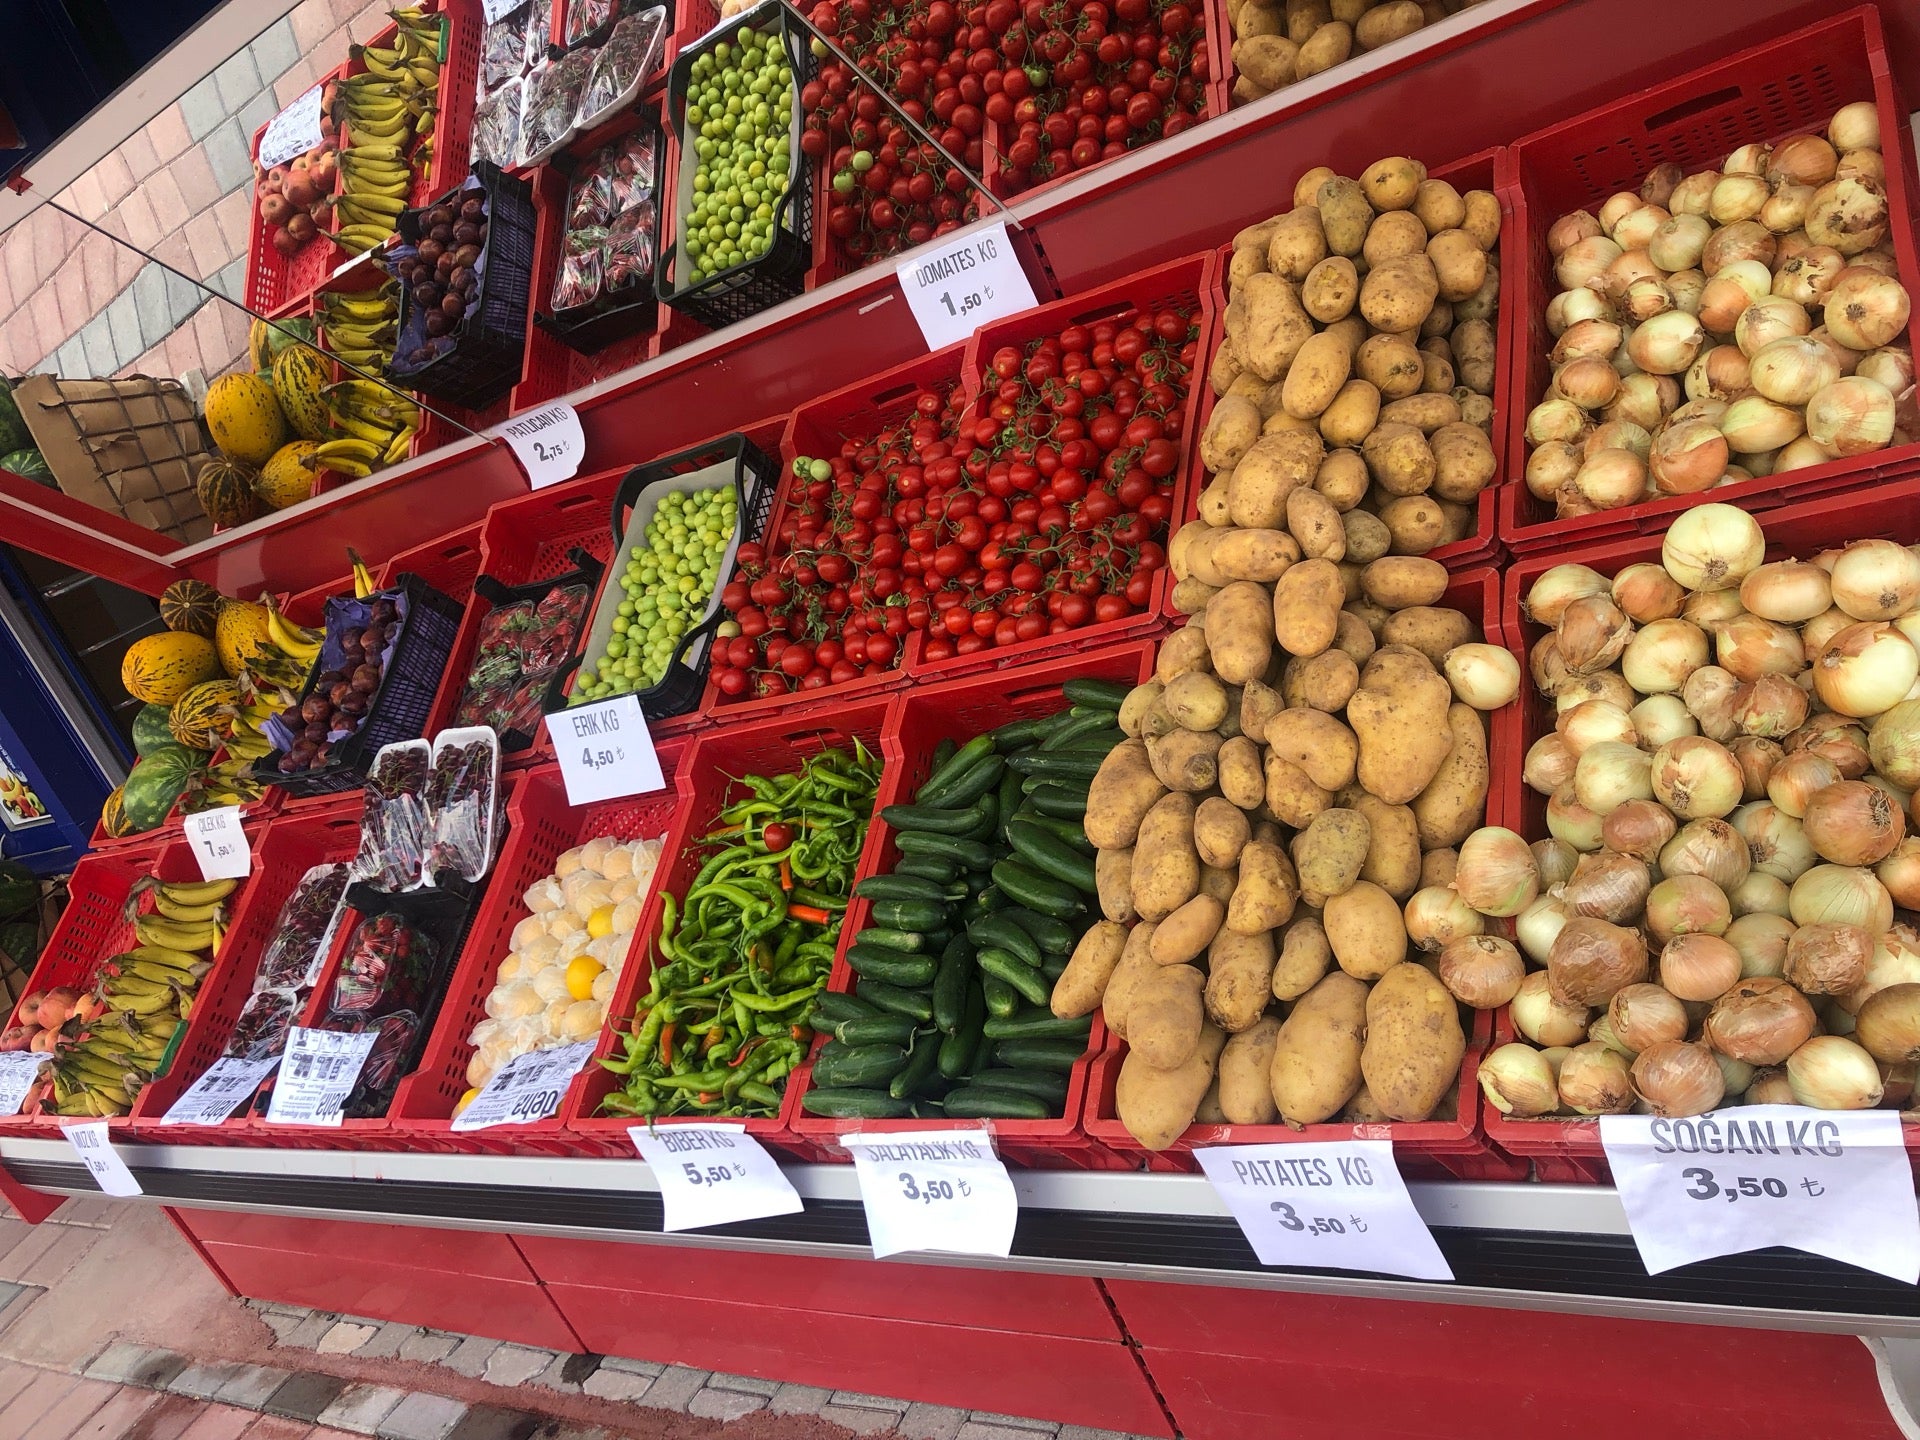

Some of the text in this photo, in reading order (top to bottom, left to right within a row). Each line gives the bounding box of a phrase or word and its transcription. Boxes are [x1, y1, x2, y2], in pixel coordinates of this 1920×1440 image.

[915, 239, 998, 288] DOMATES KG
[940, 291, 982, 317] 1,50
[505, 407, 568, 439] PATLICAN KG
[533, 442, 563, 462] 2,75
[572, 709, 620, 738] ERIK KG
[582, 747, 614, 771] 4,50
[659, 1131, 736, 1153] BIBER KG
[1650, 1113, 1843, 1157] SOĞAN KG
[866, 1140, 982, 1162] SALATALIK KG
[682, 1162, 732, 1187] 5,50
[1232, 1156, 1374, 1186] PATATES KG
[1682, 1167, 1788, 1203] 3,50
[898, 1172, 954, 1204] 3,50
[1270, 1201, 1346, 1236] 3,50
